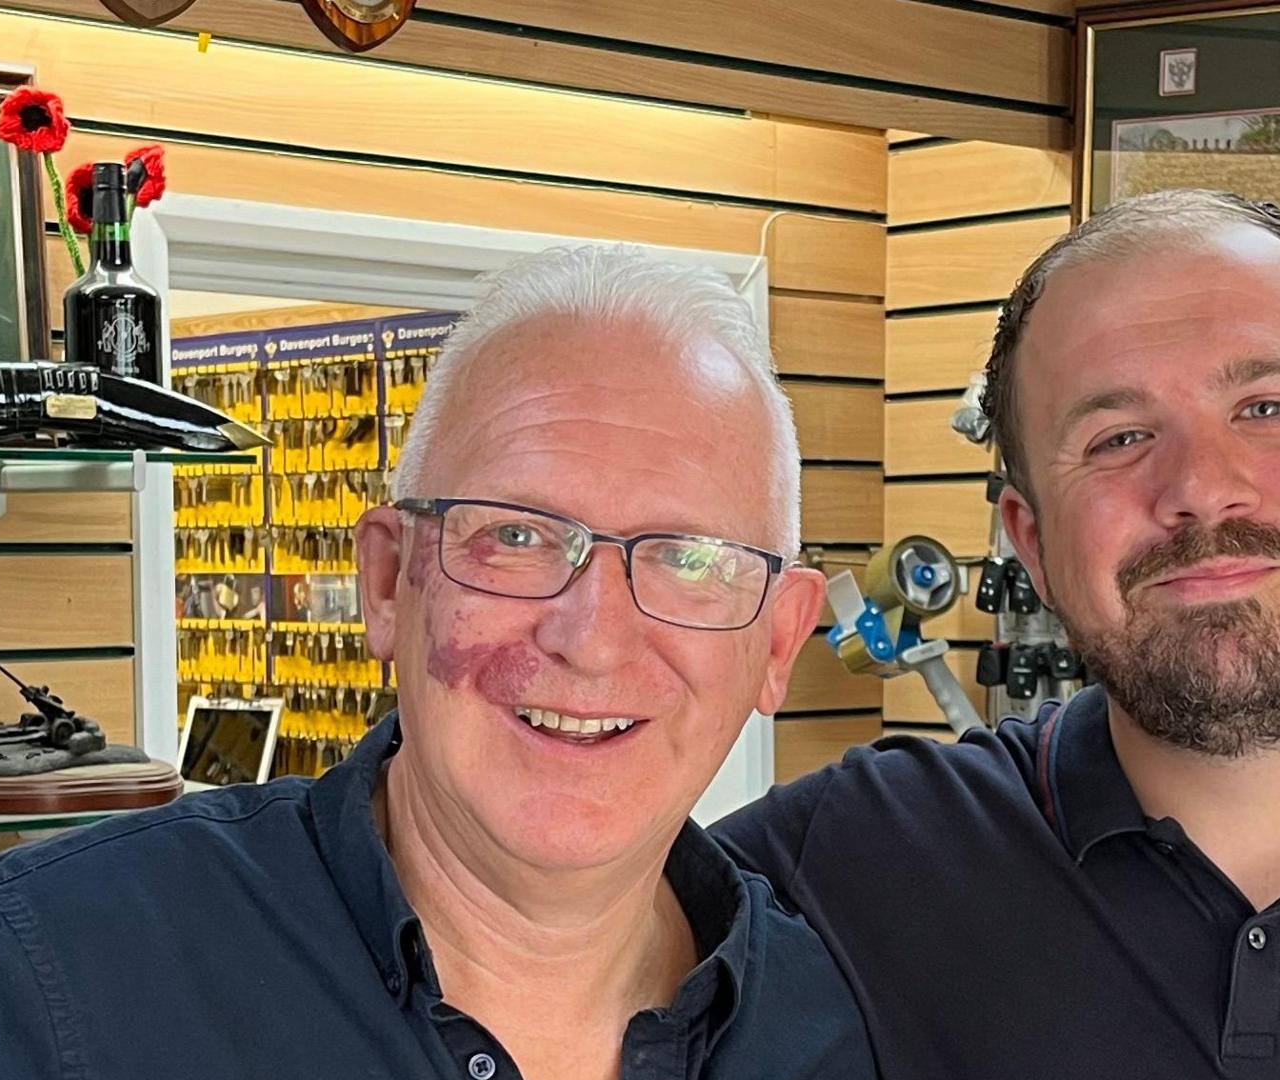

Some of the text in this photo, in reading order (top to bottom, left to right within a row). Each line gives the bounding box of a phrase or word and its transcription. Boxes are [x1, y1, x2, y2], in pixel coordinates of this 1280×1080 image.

[398, 324, 453, 340] Davenport
[280, 334, 330, 351] Davenport
[172, 344, 218, 360] Davenport
